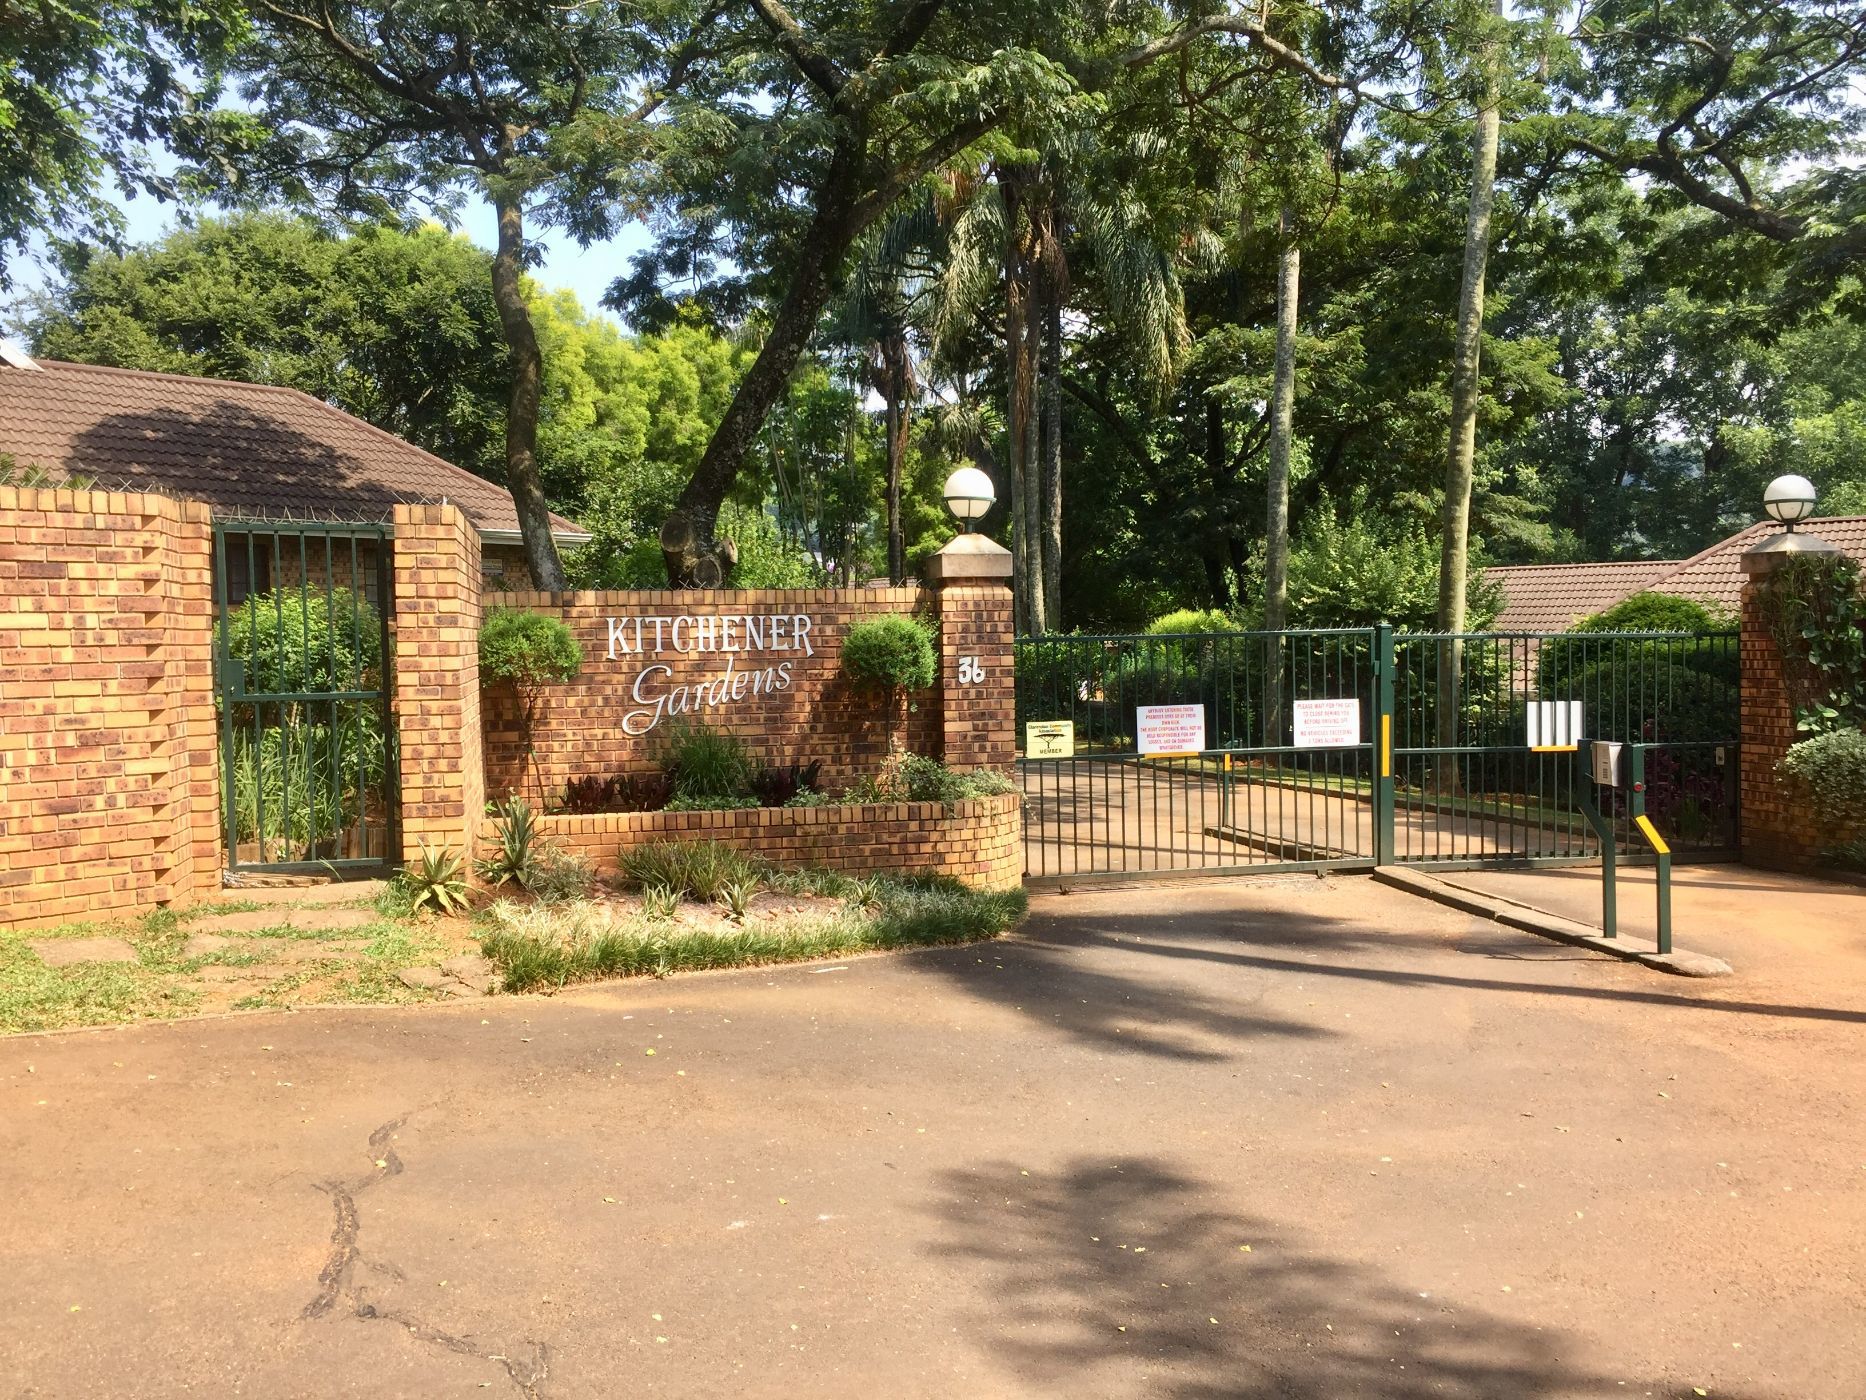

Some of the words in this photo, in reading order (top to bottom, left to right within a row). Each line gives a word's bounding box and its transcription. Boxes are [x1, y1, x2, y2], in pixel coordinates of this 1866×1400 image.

[606, 614, 815, 660] KITCHENER
[958, 656, 986, 685] 36
[621, 656, 792, 736] Gardens
